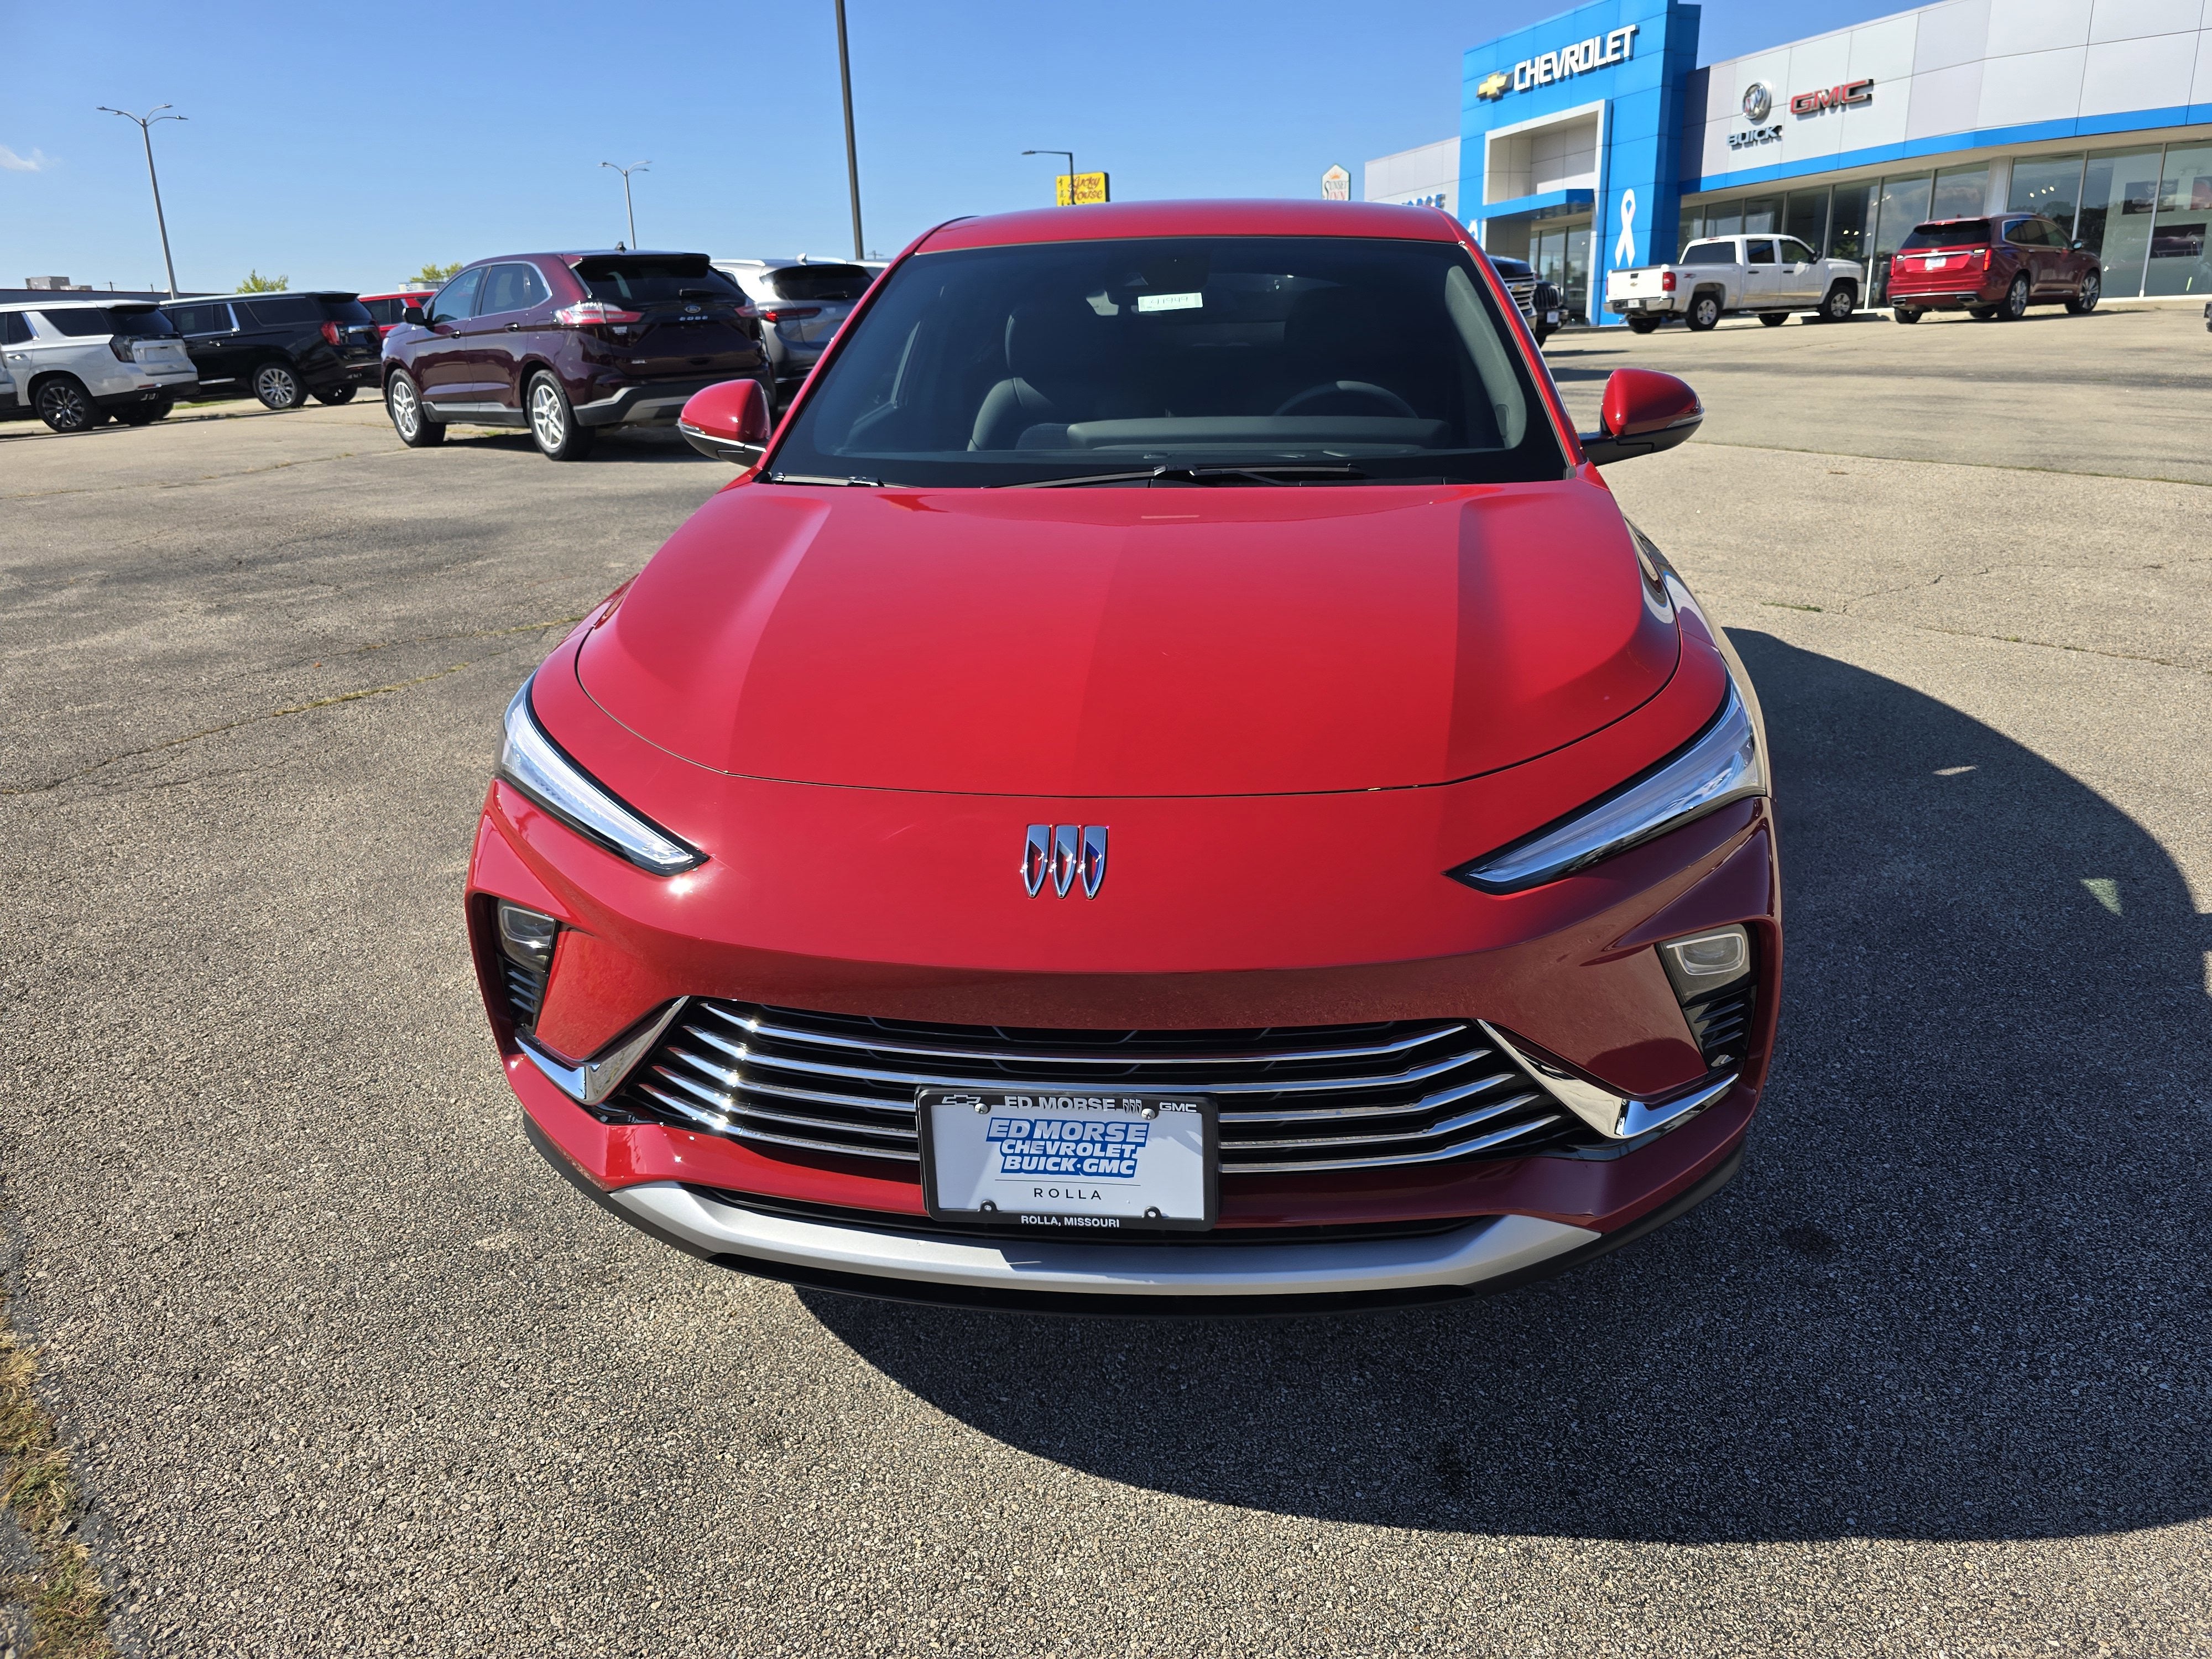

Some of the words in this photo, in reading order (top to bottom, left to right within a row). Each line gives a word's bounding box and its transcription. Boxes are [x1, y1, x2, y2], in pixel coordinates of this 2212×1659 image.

[1514, 24, 1636, 91] CHEVROLET
[1790, 79, 1872, 115] GMC
[1727, 126, 1779, 147] BUICK
[1004, 1096, 1032, 1109] ED
[1039, 1097, 1116, 1111] MORSE
[1159, 1102, 1197, 1112] GMC
[988, 1119, 1031, 1139] ED
[1033, 1121, 1149, 1142] MORSE
[1001, 1139, 1138, 1158] CHEVROLET
[1034, 1188, 1102, 1200] ROLLA
[1021, 1215, 1061, 1227] ROLLA,
[1063, 1217, 1120, 1228] MISSOURI
